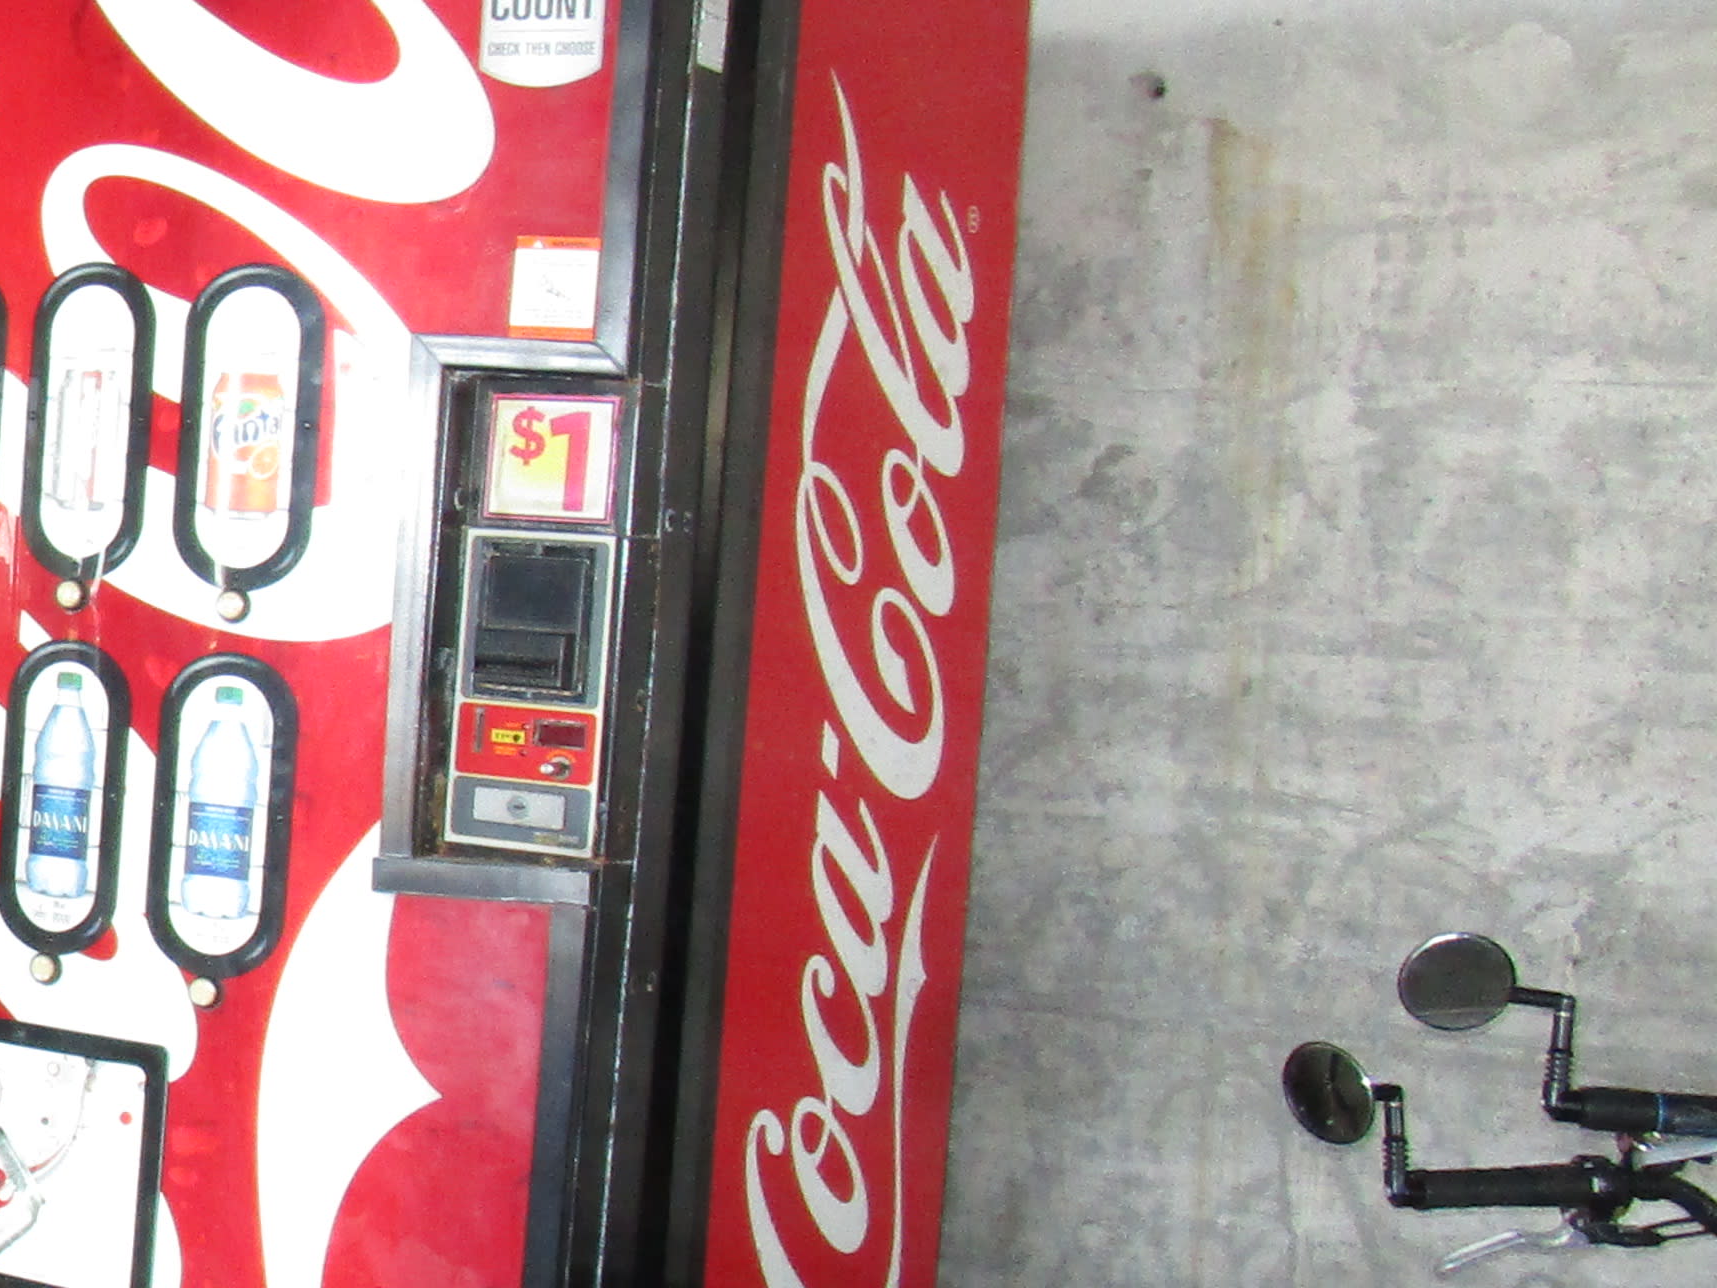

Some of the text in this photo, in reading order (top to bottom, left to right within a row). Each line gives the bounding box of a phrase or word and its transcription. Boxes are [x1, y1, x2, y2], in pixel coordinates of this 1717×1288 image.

[487, 40, 596, 57] CHECK THEN CHOOSE
[508, 405, 592, 512] $1
